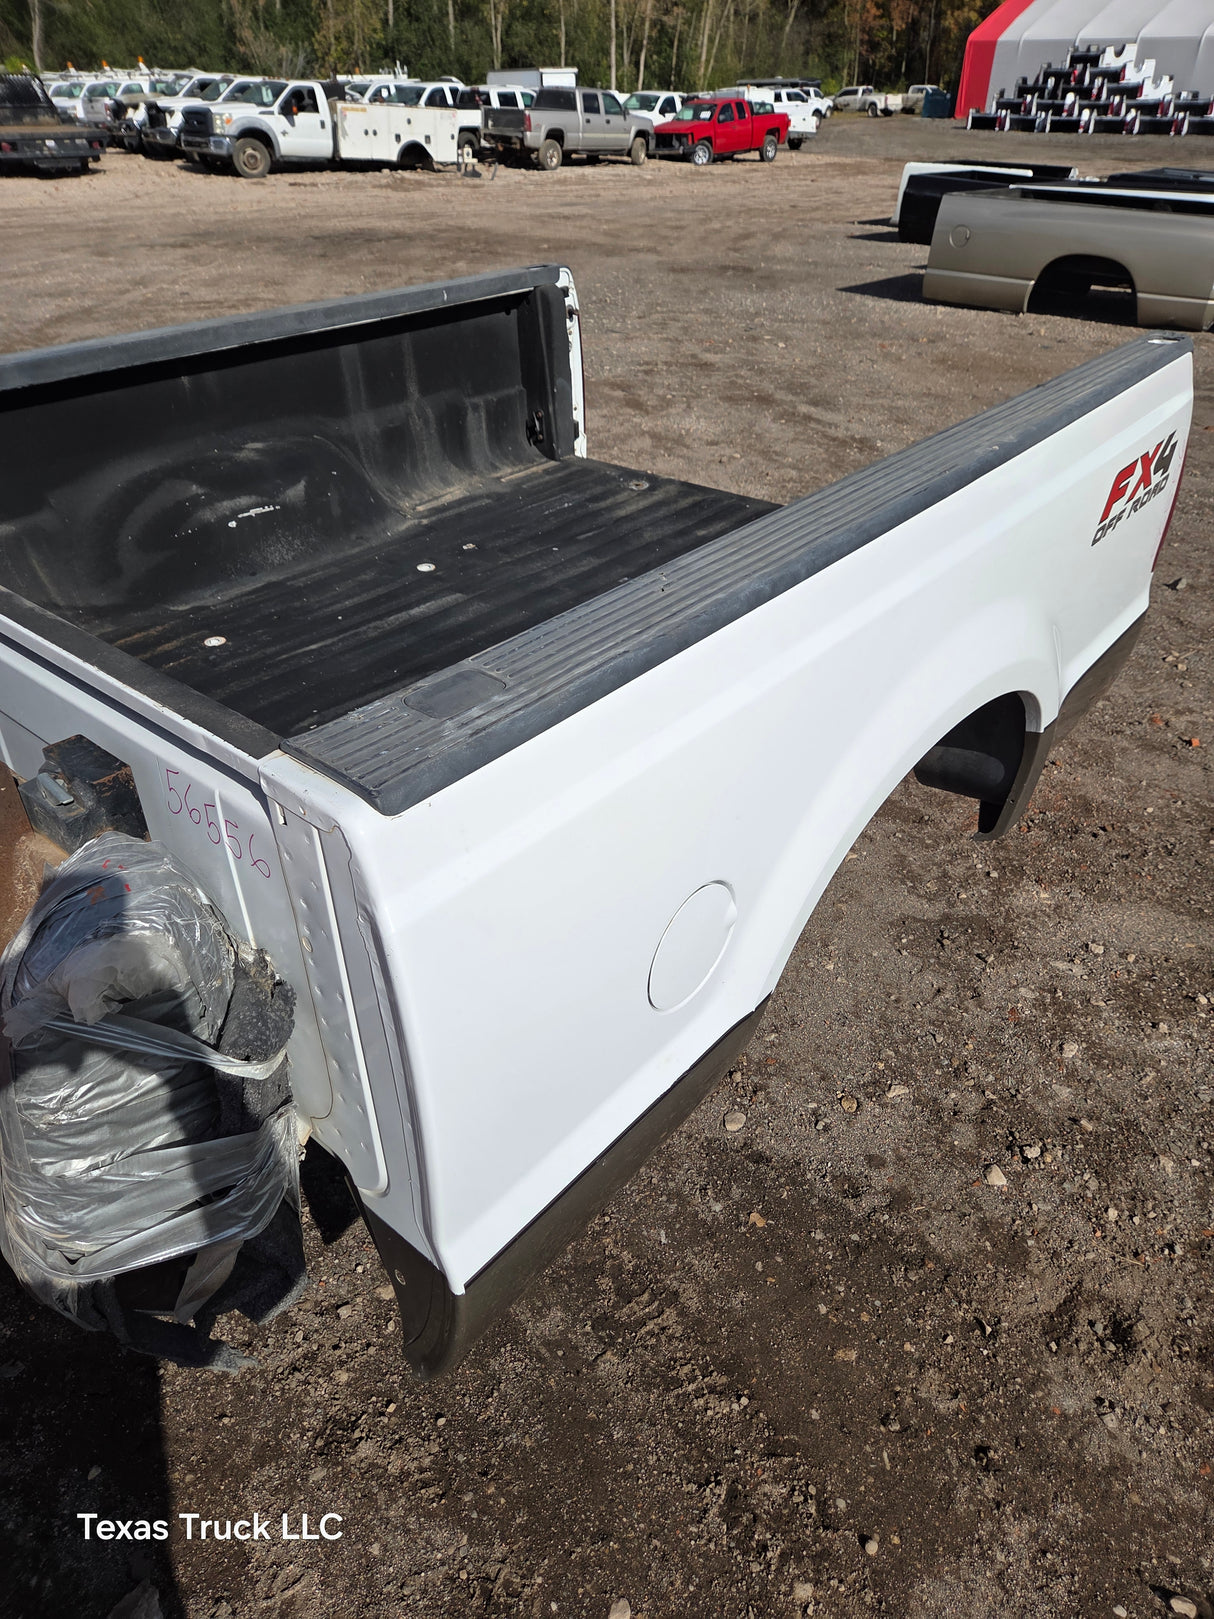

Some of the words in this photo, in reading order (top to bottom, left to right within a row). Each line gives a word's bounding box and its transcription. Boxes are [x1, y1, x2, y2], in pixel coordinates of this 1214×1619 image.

[1091, 506, 1127, 547] OFF
[1126, 472, 1170, 520] ROAD
[1098, 429, 1178, 526] FX4
[165, 768, 271, 879] 56556
